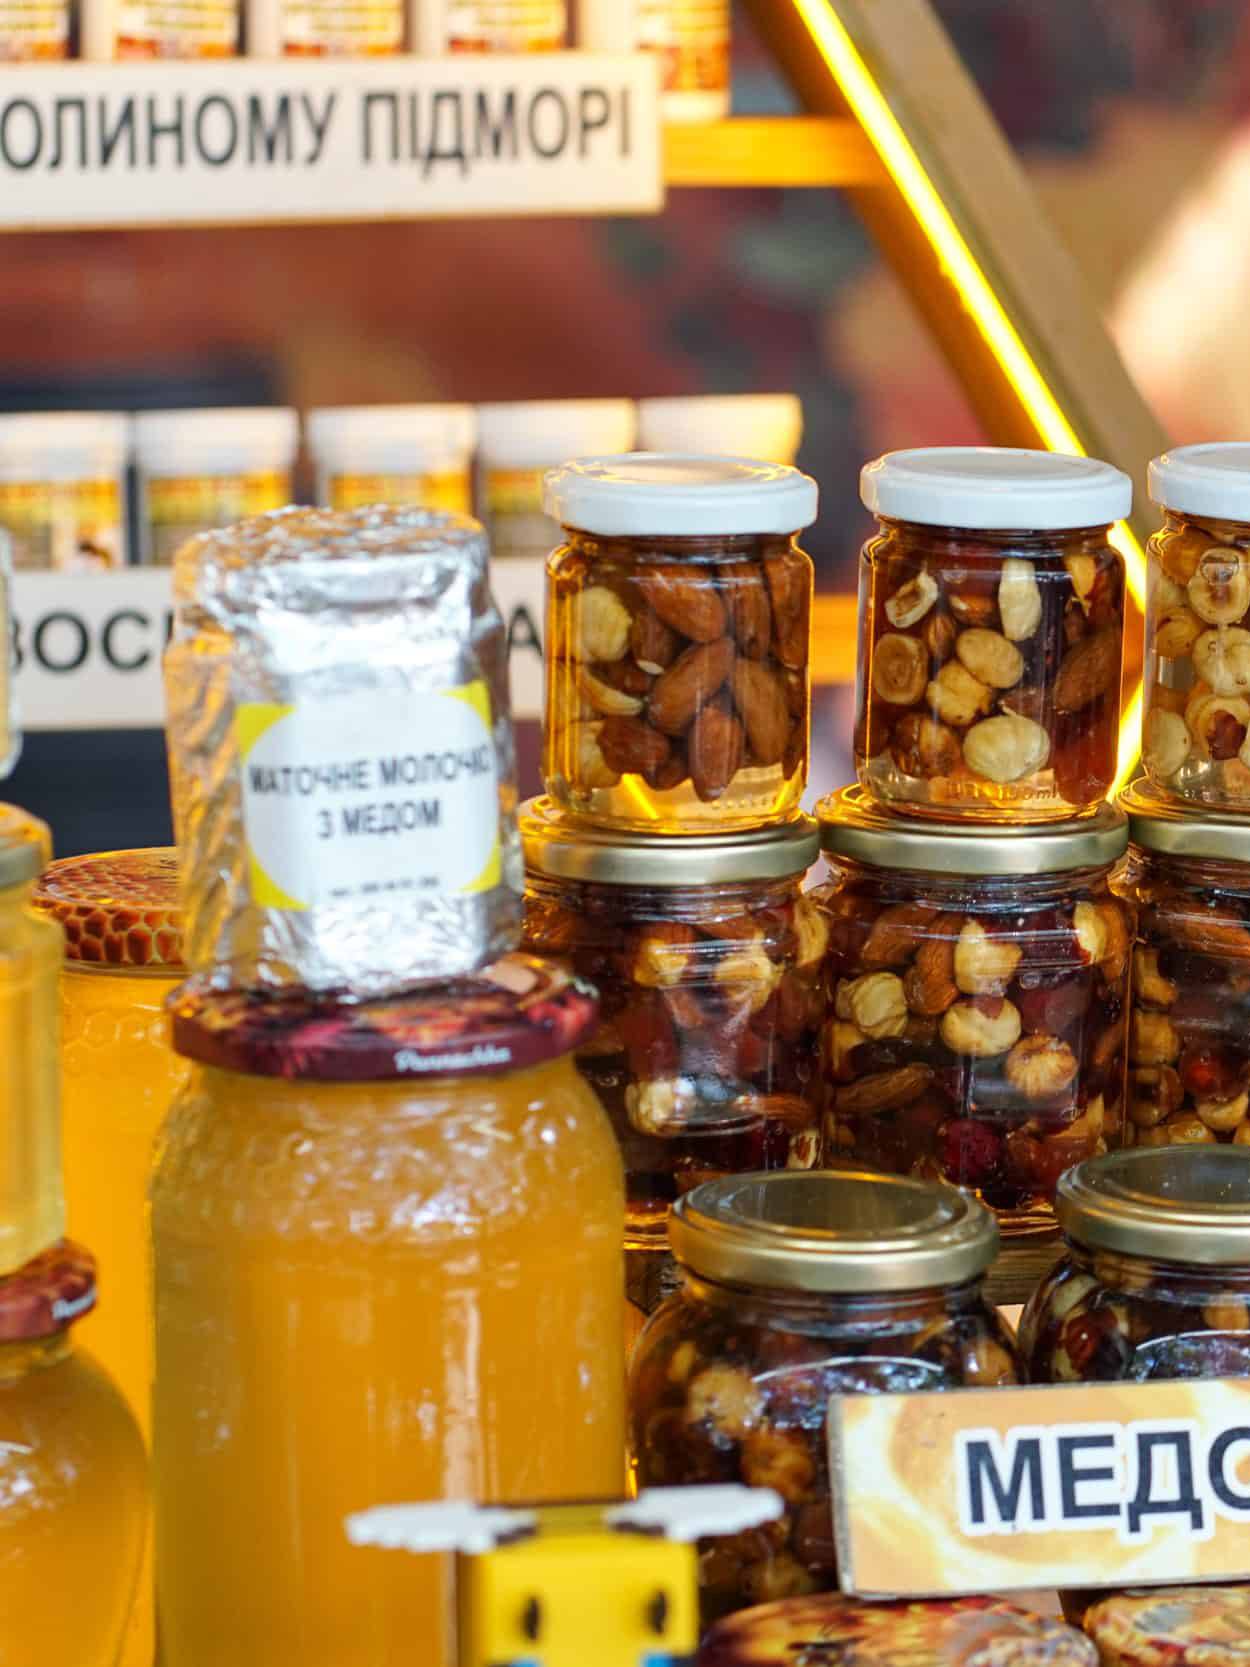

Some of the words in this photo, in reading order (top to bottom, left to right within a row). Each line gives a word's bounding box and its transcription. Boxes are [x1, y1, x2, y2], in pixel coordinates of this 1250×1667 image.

[0, 92, 335, 170] ОЛИНОМУ
[361, 87, 631, 179] ПІДМОРІ
[249, 758, 370, 797] МАТОЧНЕ
[342, 799, 440, 837] МЕДОМ
